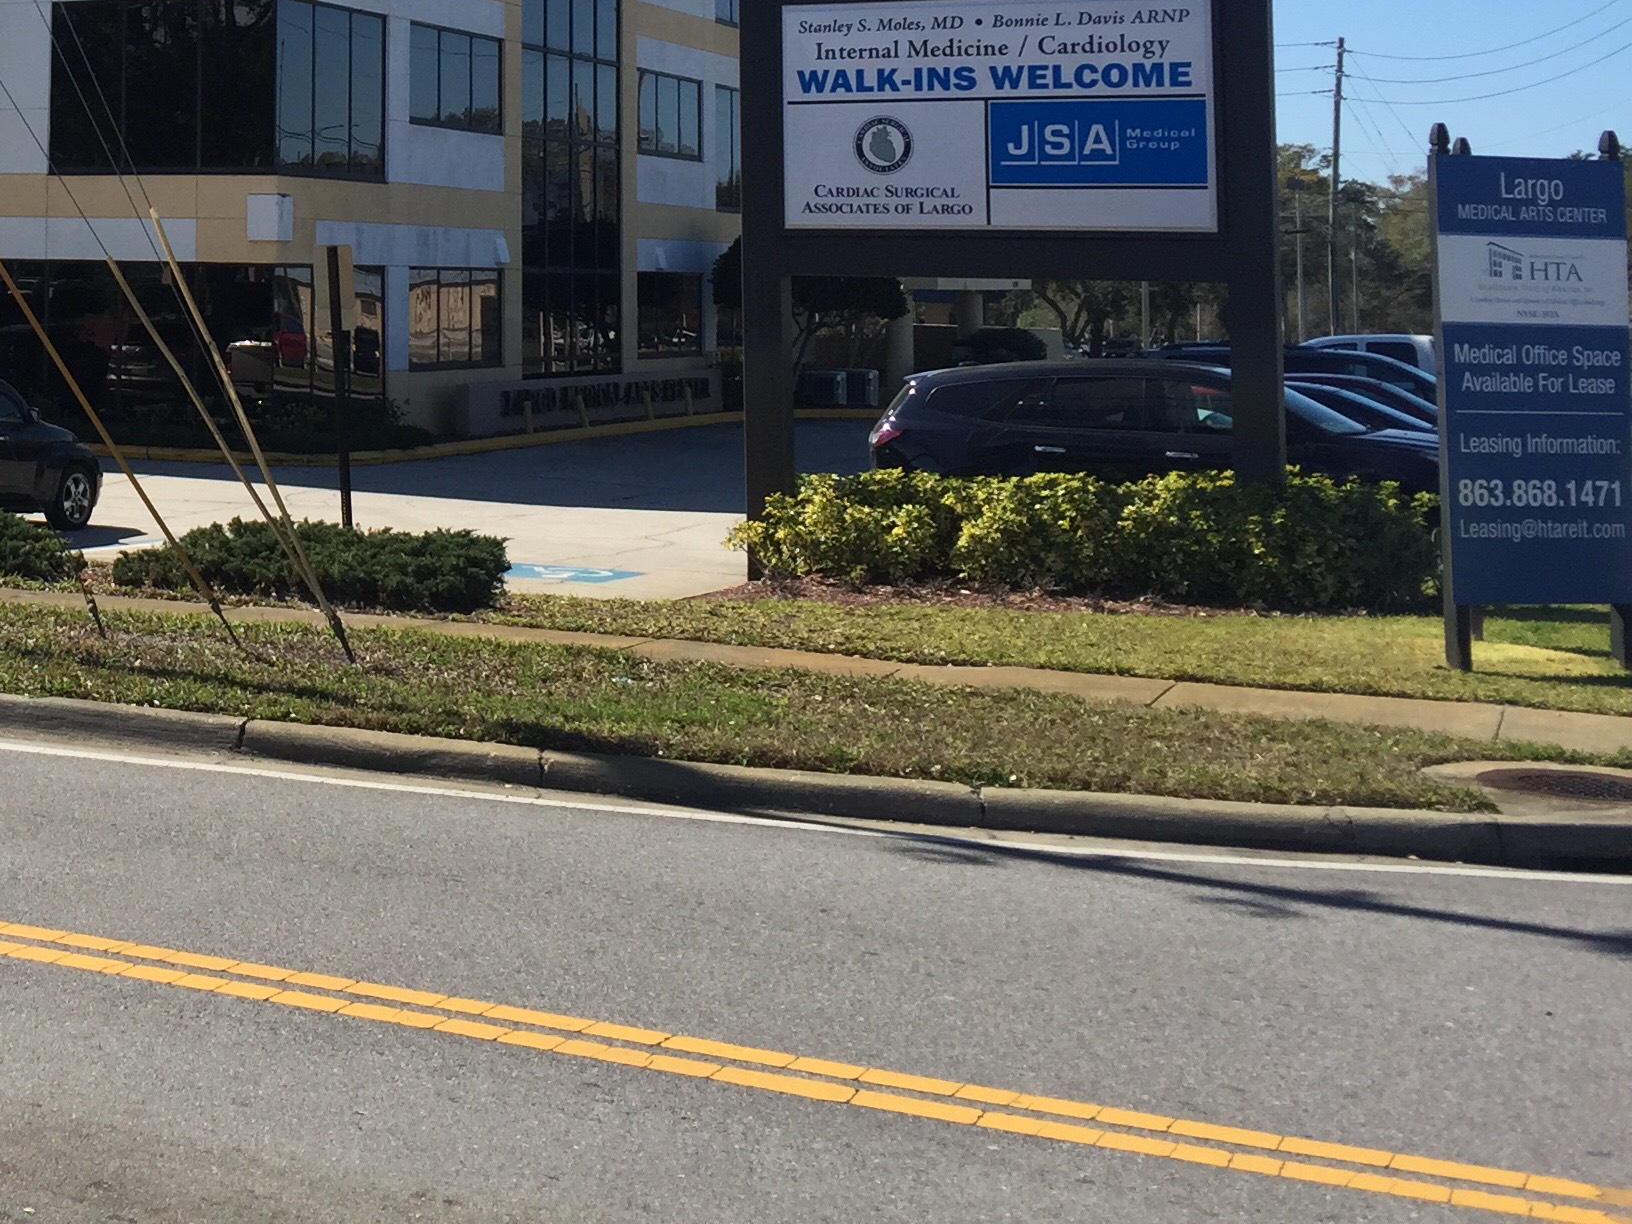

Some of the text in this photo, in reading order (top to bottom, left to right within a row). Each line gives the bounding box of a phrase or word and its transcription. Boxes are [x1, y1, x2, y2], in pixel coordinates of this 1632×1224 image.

[798, 8, 1191, 37] Stanley S. Moles, MD Bonnie L. Davis ARNP
[815, 33, 1171, 61] Internal Medicine / Cardiology
[796, 61, 1193, 94] WALK-INS WELCOME
[1006, 123, 1114, 157] JSA
[1126, 127, 1196, 138] Medical
[1126, 139, 1180, 151] Group
[1499, 171, 1564, 206] Largo
[1457, 203, 1608, 224] MEDICAL ARTS CENTER
[1529, 261, 1584, 283] HTA
[1454, 343, 1622, 370] Medical Office Space
[1461, 371, 1616, 394] Available For Lease
[1460, 432, 1622, 458] Leasing Information:
[1457, 478, 1622, 508] 863.868.1471
[1459, 518, 1626, 543] Leasing@htareit.com
